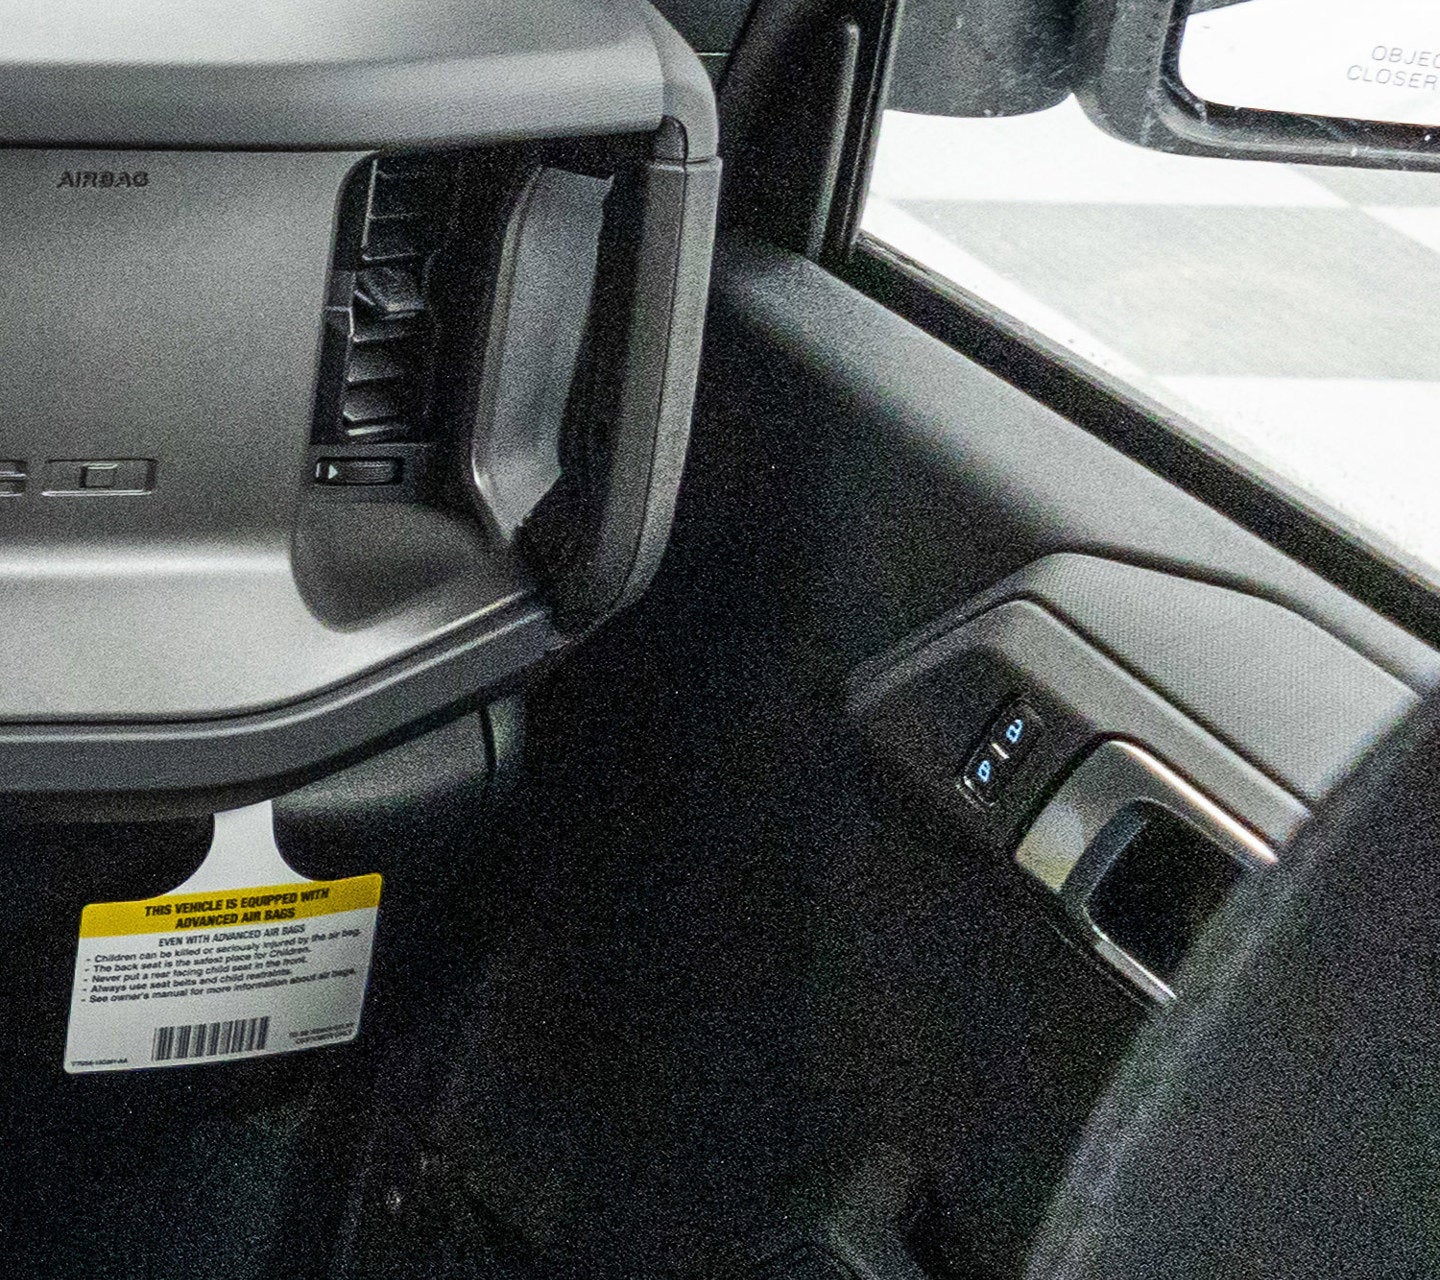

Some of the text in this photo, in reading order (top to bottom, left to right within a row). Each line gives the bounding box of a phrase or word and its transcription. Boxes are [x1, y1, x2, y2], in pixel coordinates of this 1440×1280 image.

[1346, 64, 1438, 91] CLOSER
[57, 169, 150, 190] AIRBAG
[145, 888, 330, 917] THIS VEHICLE IS EQUIPPED WITH
[175, 907, 296, 930] ADVANCED AIR BAGS
[158, 924, 306, 948] EVEN WITH ADVANCED AIR BAGS
[94, 950, 137, 964] Children
[139, 951, 157, 961] can
[159, 948, 172, 959] be
[174, 946, 201, 957] killed
[93, 963, 112, 974] The
[114, 961, 138, 972] back
[91, 973, 122, 984] Never
[90, 983, 126, 995] Always
[89, 994, 108, 1004] See
